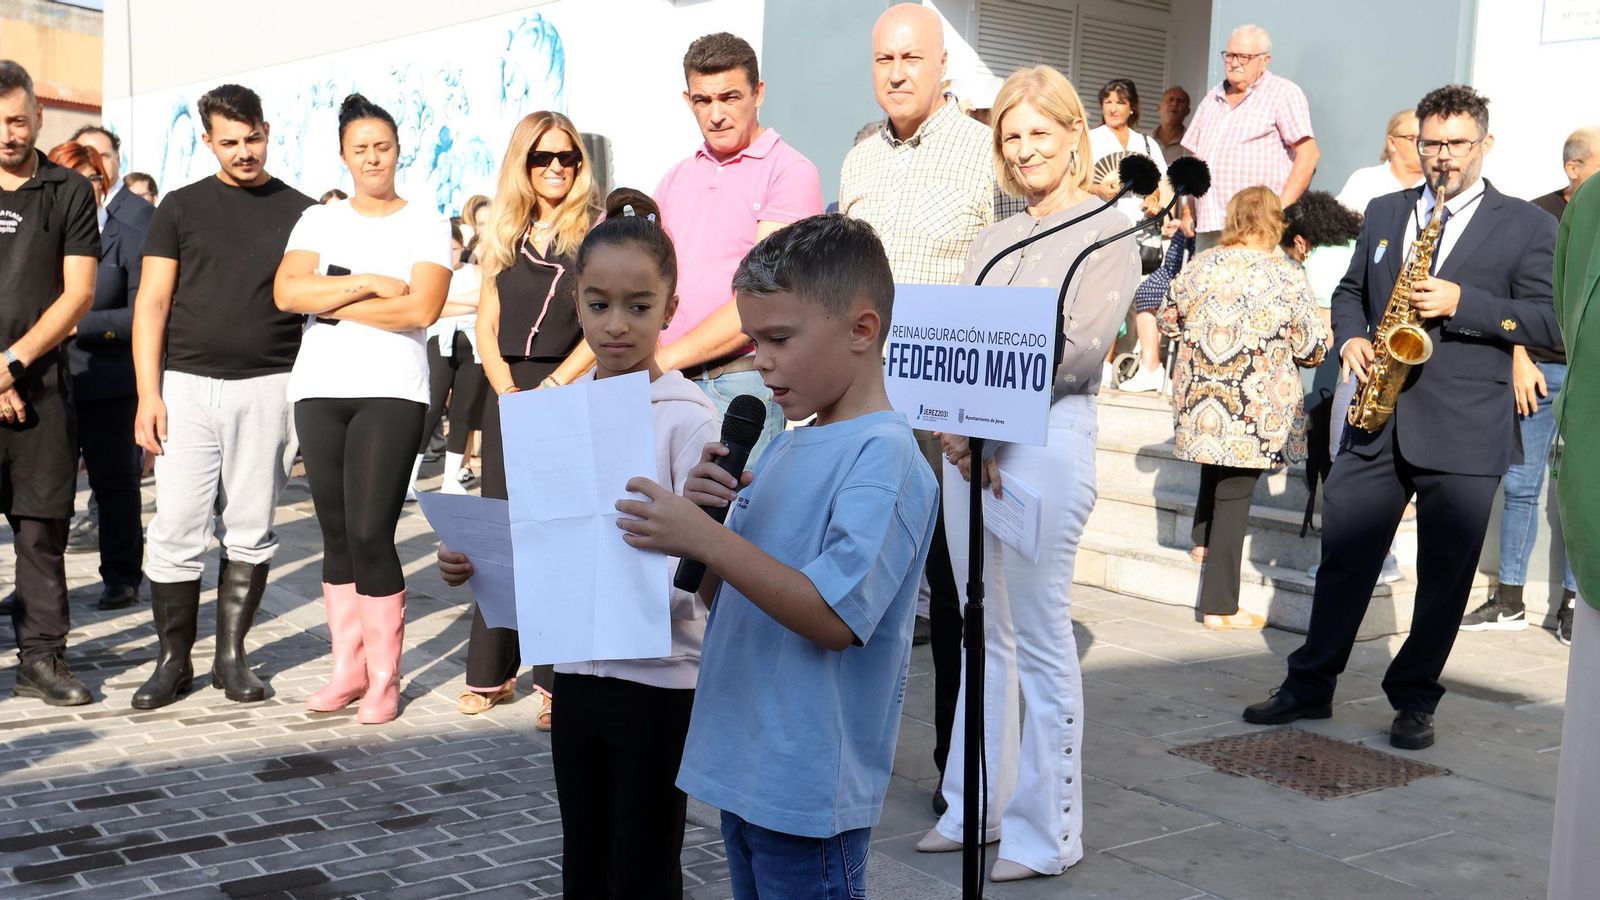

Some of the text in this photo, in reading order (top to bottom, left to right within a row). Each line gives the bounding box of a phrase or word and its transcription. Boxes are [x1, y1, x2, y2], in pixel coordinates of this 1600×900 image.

[892, 325, 1047, 348] REINAUGURACIÓN MERCADO
[888, 342, 1047, 392] FEDERICO MAYO
[923, 408, 949, 419] JEREZ2031
[965, 415, 990, 423] Ayuntamiento
